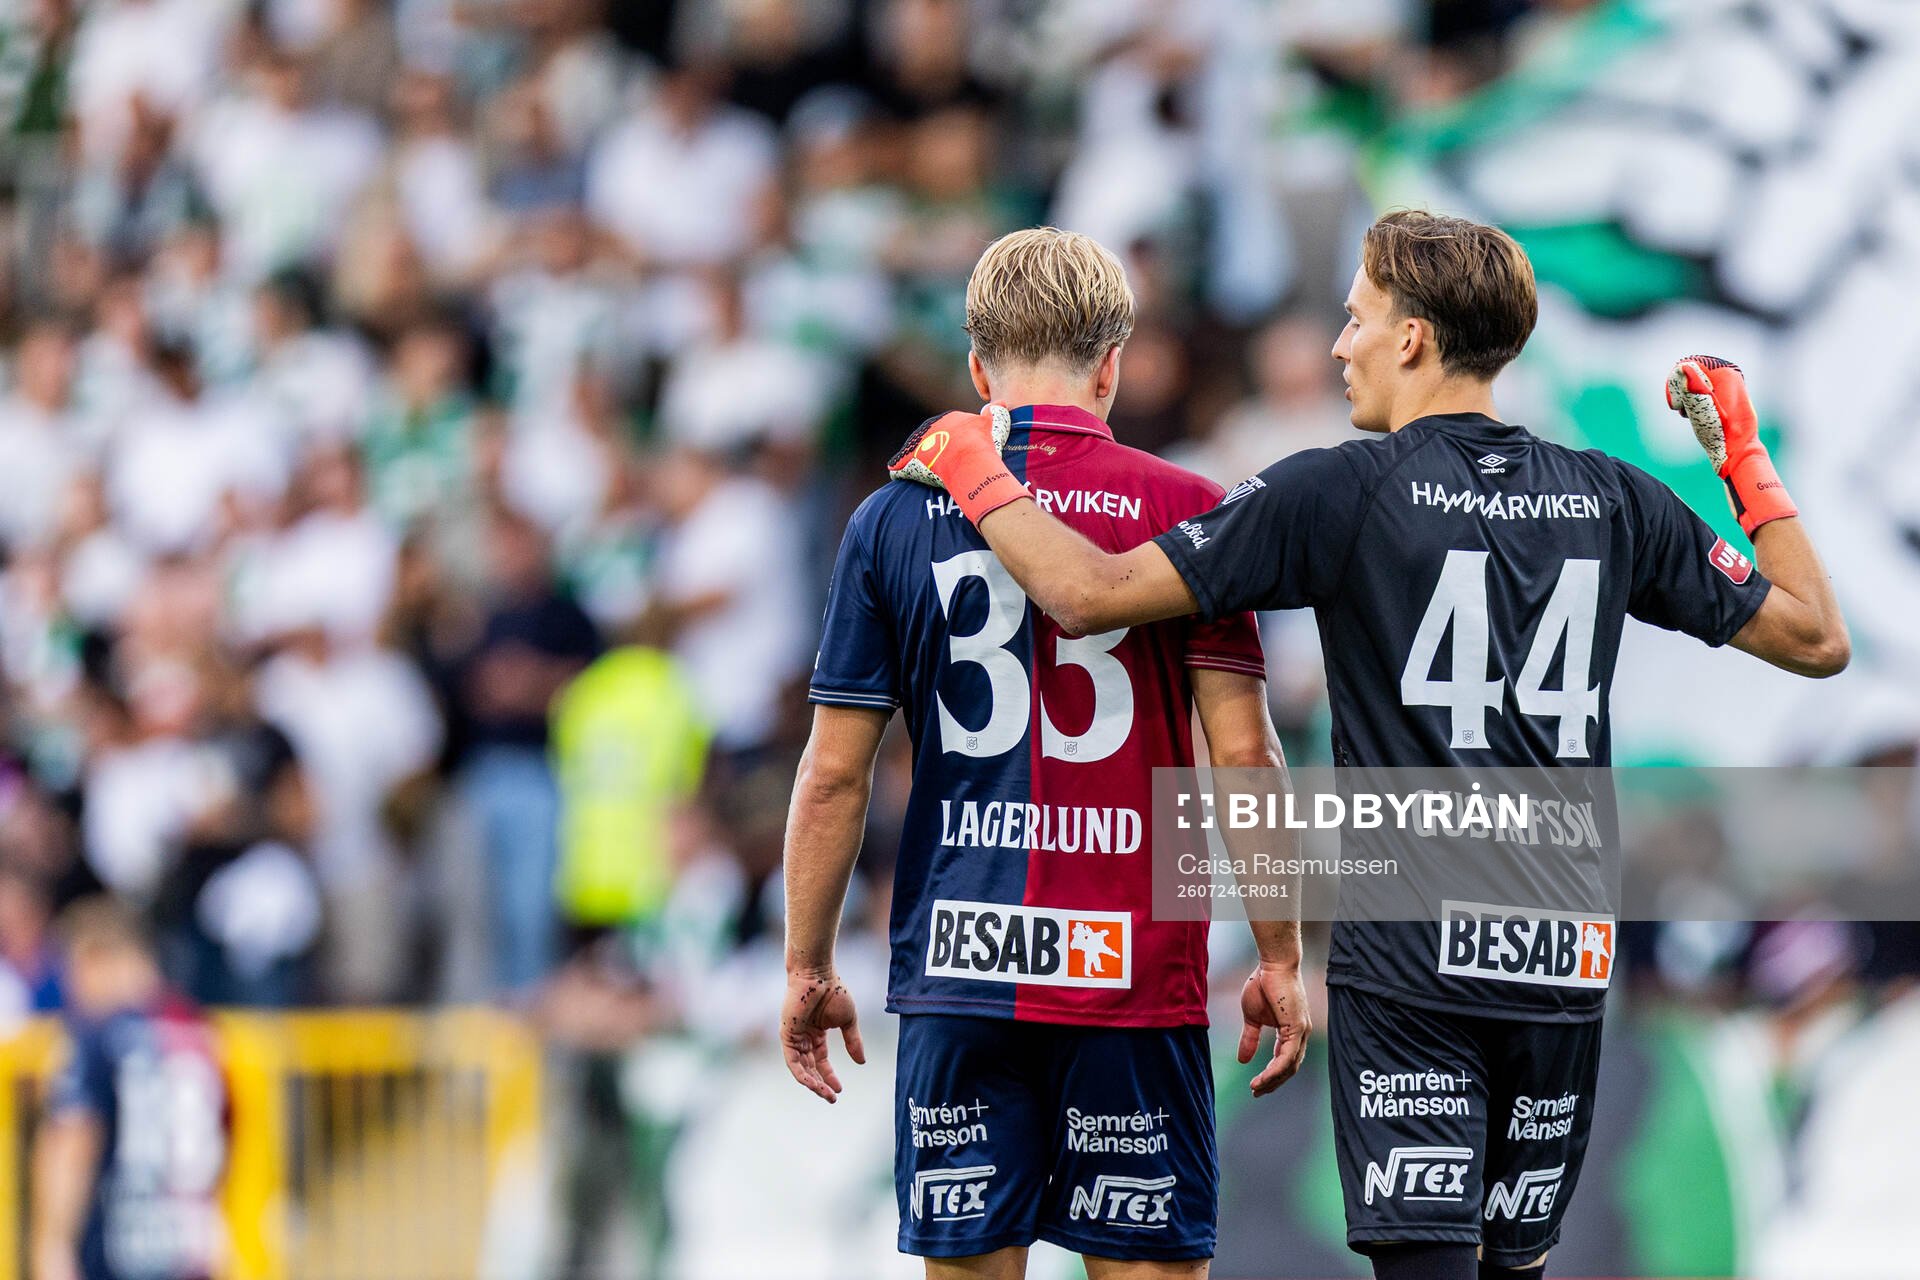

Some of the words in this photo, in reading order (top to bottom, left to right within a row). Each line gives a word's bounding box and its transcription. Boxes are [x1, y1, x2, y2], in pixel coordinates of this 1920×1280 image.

[1481, 467, 1506, 475] umbro
[1411, 481, 1601, 520] HAMMARVIKEN
[931, 549, 1134, 763] 33
[1400, 549, 1601, 759] 44
[940, 799, 1142, 854] LAGERLUND
[931, 909, 1061, 976] BESAB
[1447, 910, 1577, 977] BESAB
[1360, 1092, 1470, 1118] Månsson
[1067, 1131, 1168, 1155] Månsson
[1069, 1174, 1176, 1228] NTEX
[1365, 1147, 1474, 1206] NTEX
